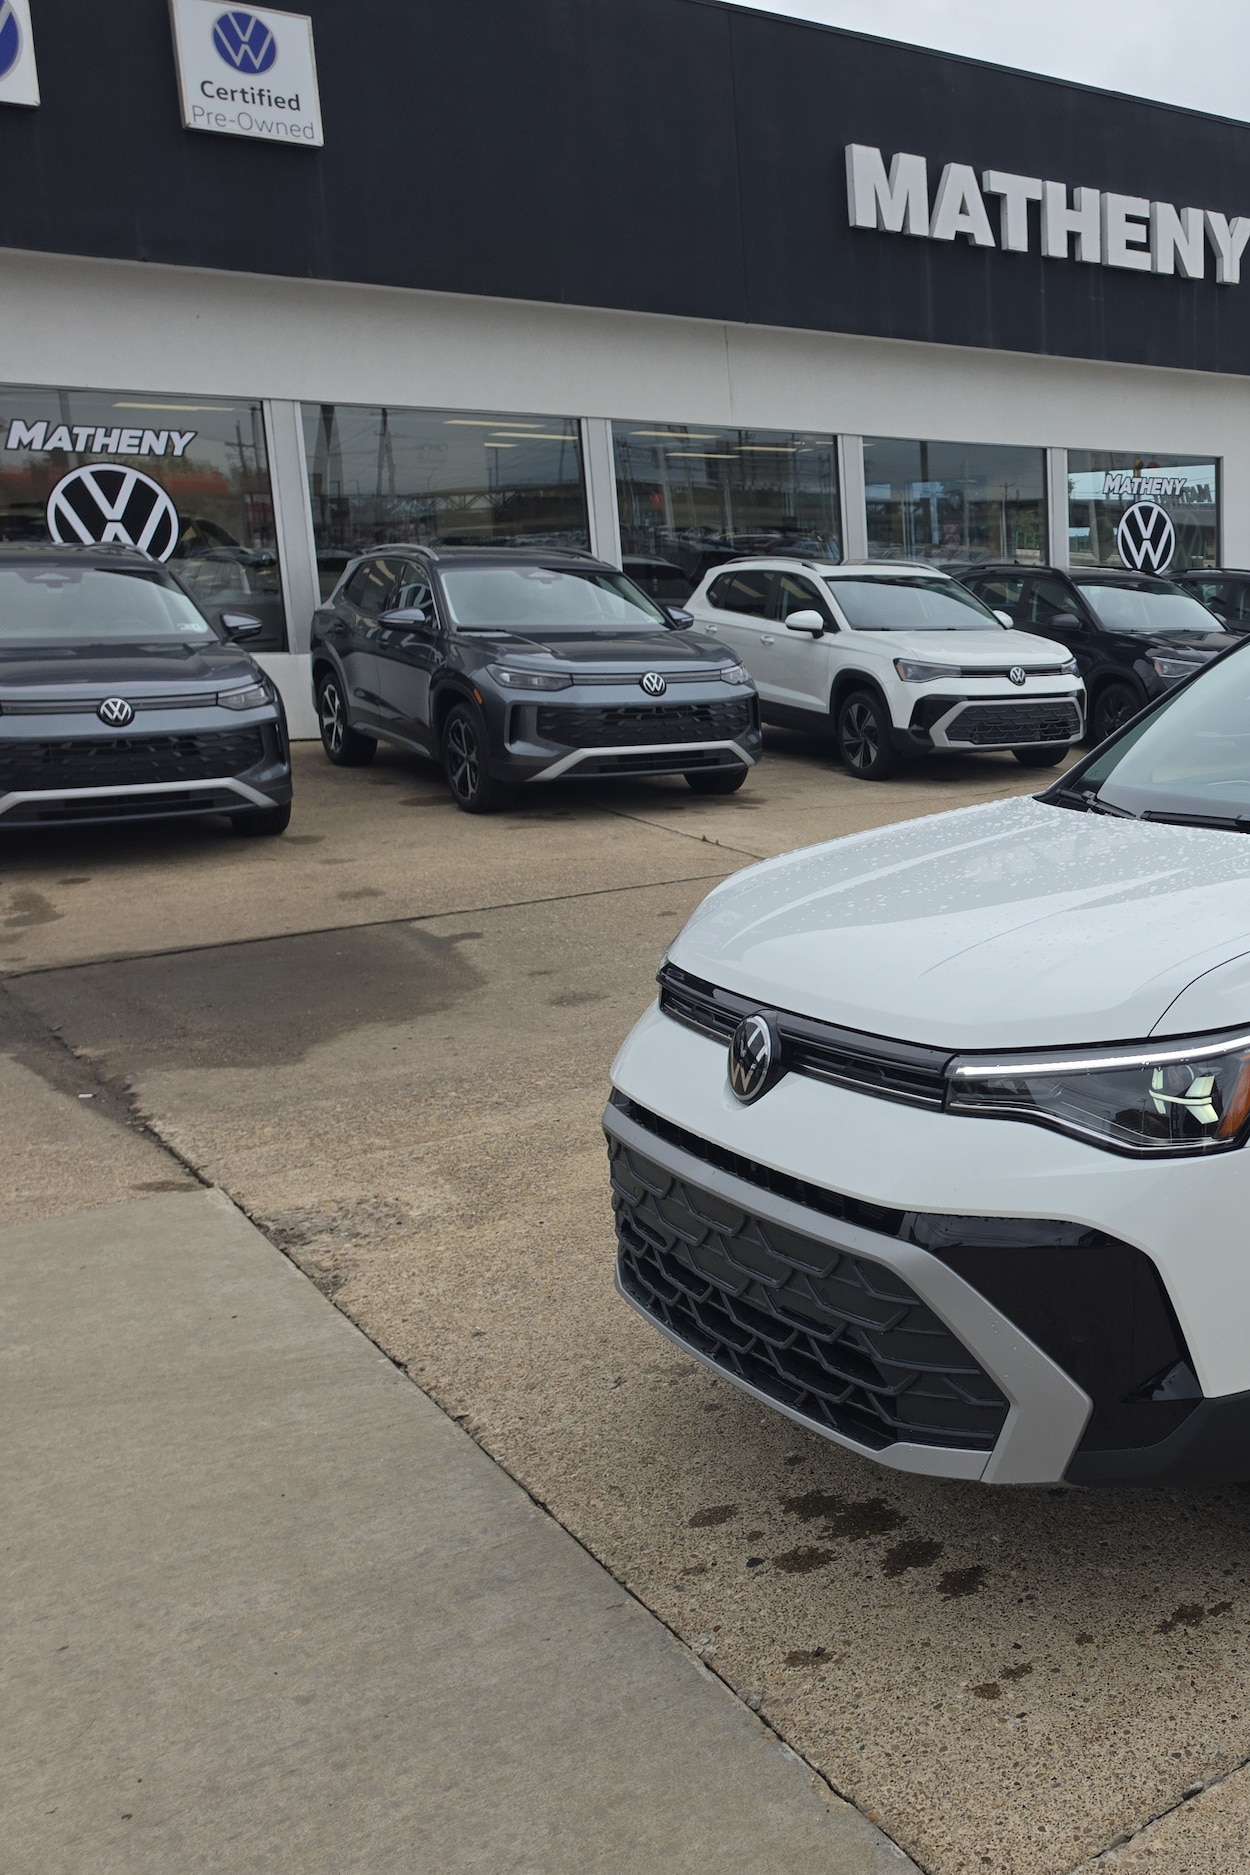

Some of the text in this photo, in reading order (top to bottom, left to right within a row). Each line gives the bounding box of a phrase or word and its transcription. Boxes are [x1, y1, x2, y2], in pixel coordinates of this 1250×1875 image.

[200, 80, 301, 111] Certified
[192, 105, 315, 139] Pre-Owned
[5, 418, 198, 457] MATHENY
[1102, 474, 1187, 496] MATHENY
